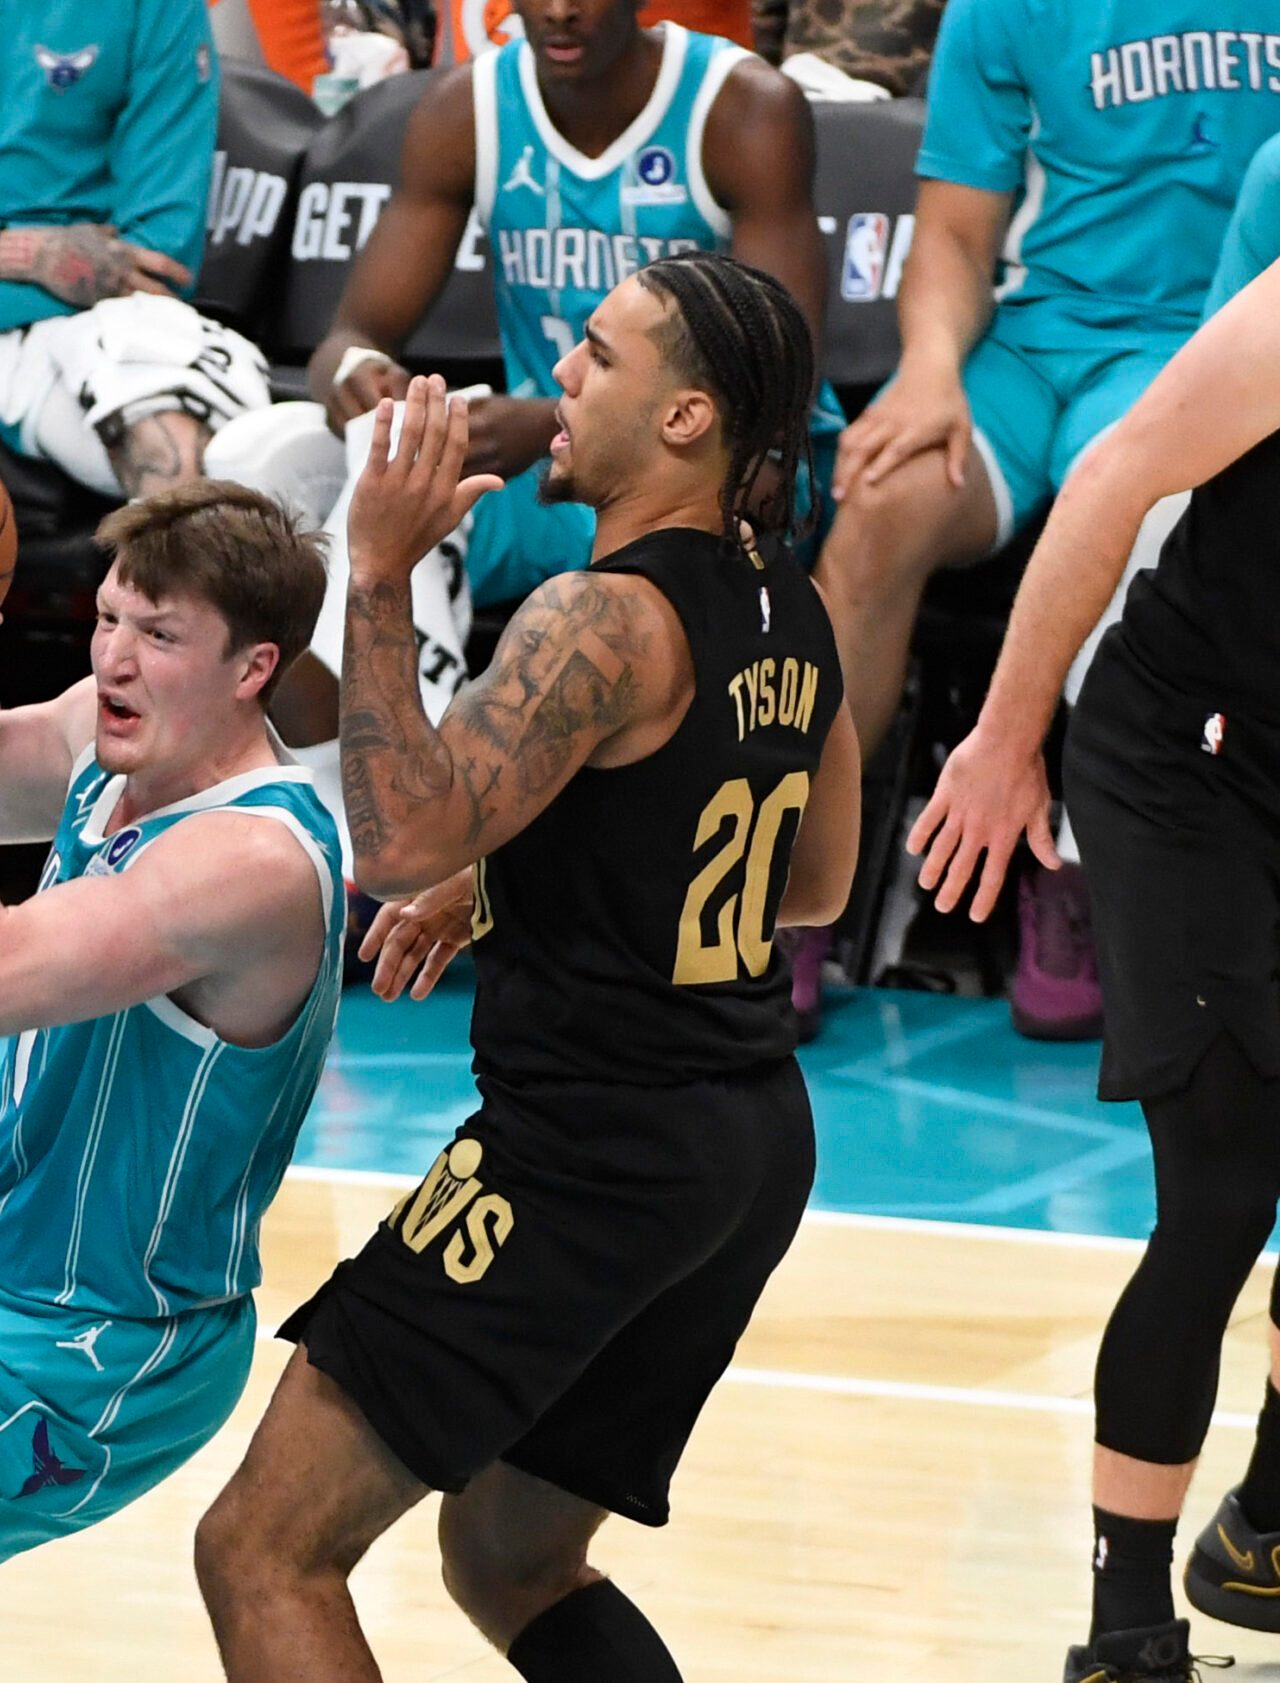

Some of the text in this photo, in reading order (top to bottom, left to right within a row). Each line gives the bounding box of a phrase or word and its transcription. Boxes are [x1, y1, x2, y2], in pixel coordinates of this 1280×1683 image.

[1090, 30, 1280, 111] HORNETS
[291, 182, 392, 261] GET
[498, 227, 699, 290] HORNET
[728, 656, 819, 742] TYSON
[671, 770, 810, 985] 20
[387, 1138, 514, 1284] VS
